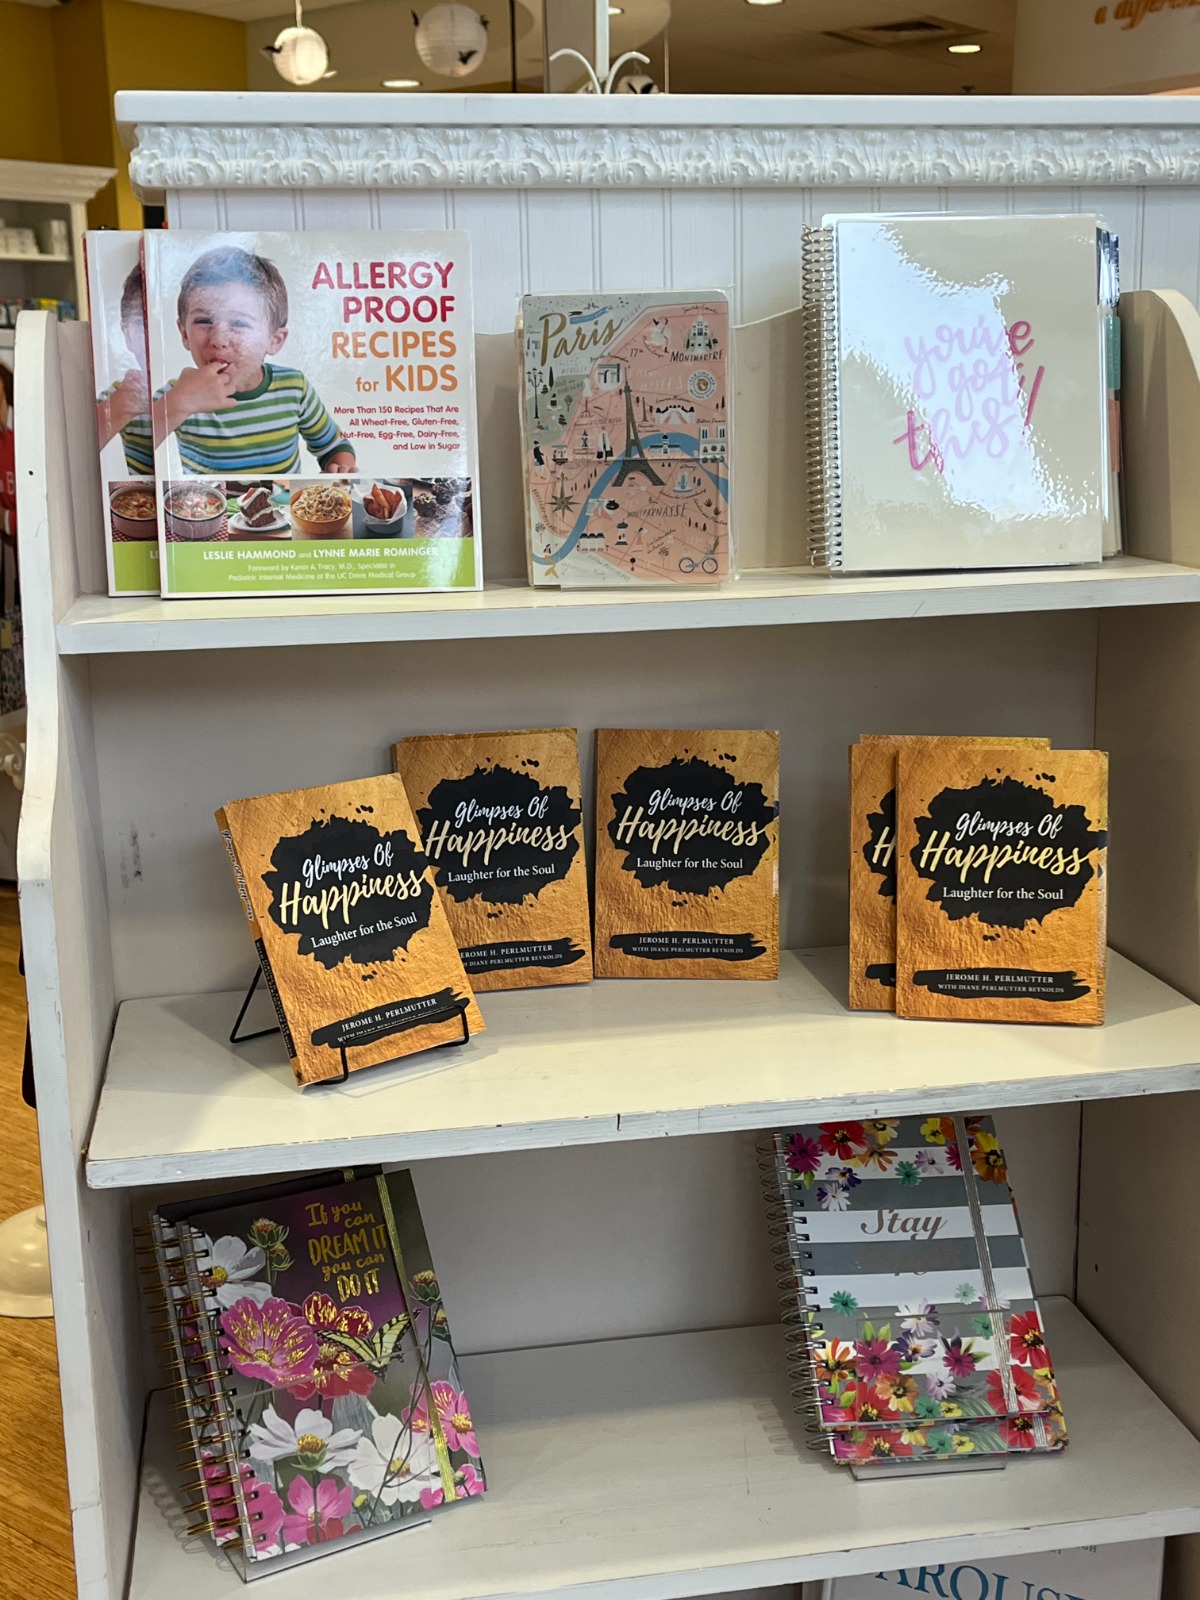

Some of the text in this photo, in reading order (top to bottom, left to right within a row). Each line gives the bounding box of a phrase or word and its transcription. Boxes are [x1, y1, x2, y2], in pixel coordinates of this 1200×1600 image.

[312, 261, 454, 290] ALLERGY
[342, 295, 456, 323] PROOF
[331, 330, 457, 359] RECIPES
[538, 312, 623, 367] Paris
[356, 364, 458, 392] for KIDS
[334, 406, 355, 414] More
[356, 406, 376, 414] Than
[378, 406, 392, 414] 150
[394, 406, 424, 414] Recipes
[349, 418, 460, 426] All Wheat-Free, Gluten-Free,
[340, 430, 460, 440] Nut-Free, Egg-Free, Dairy-Free,
[392, 442, 460, 451] and Low in Sugar
[203, 550, 234, 560] LESLIE
[238, 550, 296, 560] HAMMOND
[313, 548, 346, 558] LYNNE
[348, 548, 380, 557] MARIE
[384, 546, 438, 556] ROMINGER
[455, 795, 550, 828] Glimpses Of
[648, 788, 743, 815] Glimpses Of
[616, 805, 766, 854] Happiness
[955, 810, 1063, 842] Glimpses Of
[424, 820, 575, 868] Happiness
[919, 830, 1090, 884] Happiness
[302, 841, 394, 888] Glimpses Of
[448, 863, 556, 884] Laughter for the Soul
[636, 858, 743, 870] Laughter for the Soul
[278, 869, 429, 930] Happiness
[942, 886, 1064, 901] Laughter for the Soul
[310, 912, 418, 949] Laughter for the Soul
[460, 944, 553, 959] EROME H. PERLMUTTER
[489, 956, 530, 965] PERLMUTTER
[946, 973, 980, 981] JEROME
[994, 975, 1054, 983] PERLMUTTER
[341, 1016, 374, 1032] JEROME
[374, 1014, 384, 1022] H.
[385, 998, 438, 1019] PERLMUTTER
[304, 1201, 362, 1227] If you
[344, 1212, 376, 1228] can
[860, 1205, 949, 1242] Stay
[308, 1224, 387, 1266] DREAM IT
[322, 1253, 385, 1282] you can
[336, 1267, 380, 1303] DO IT
